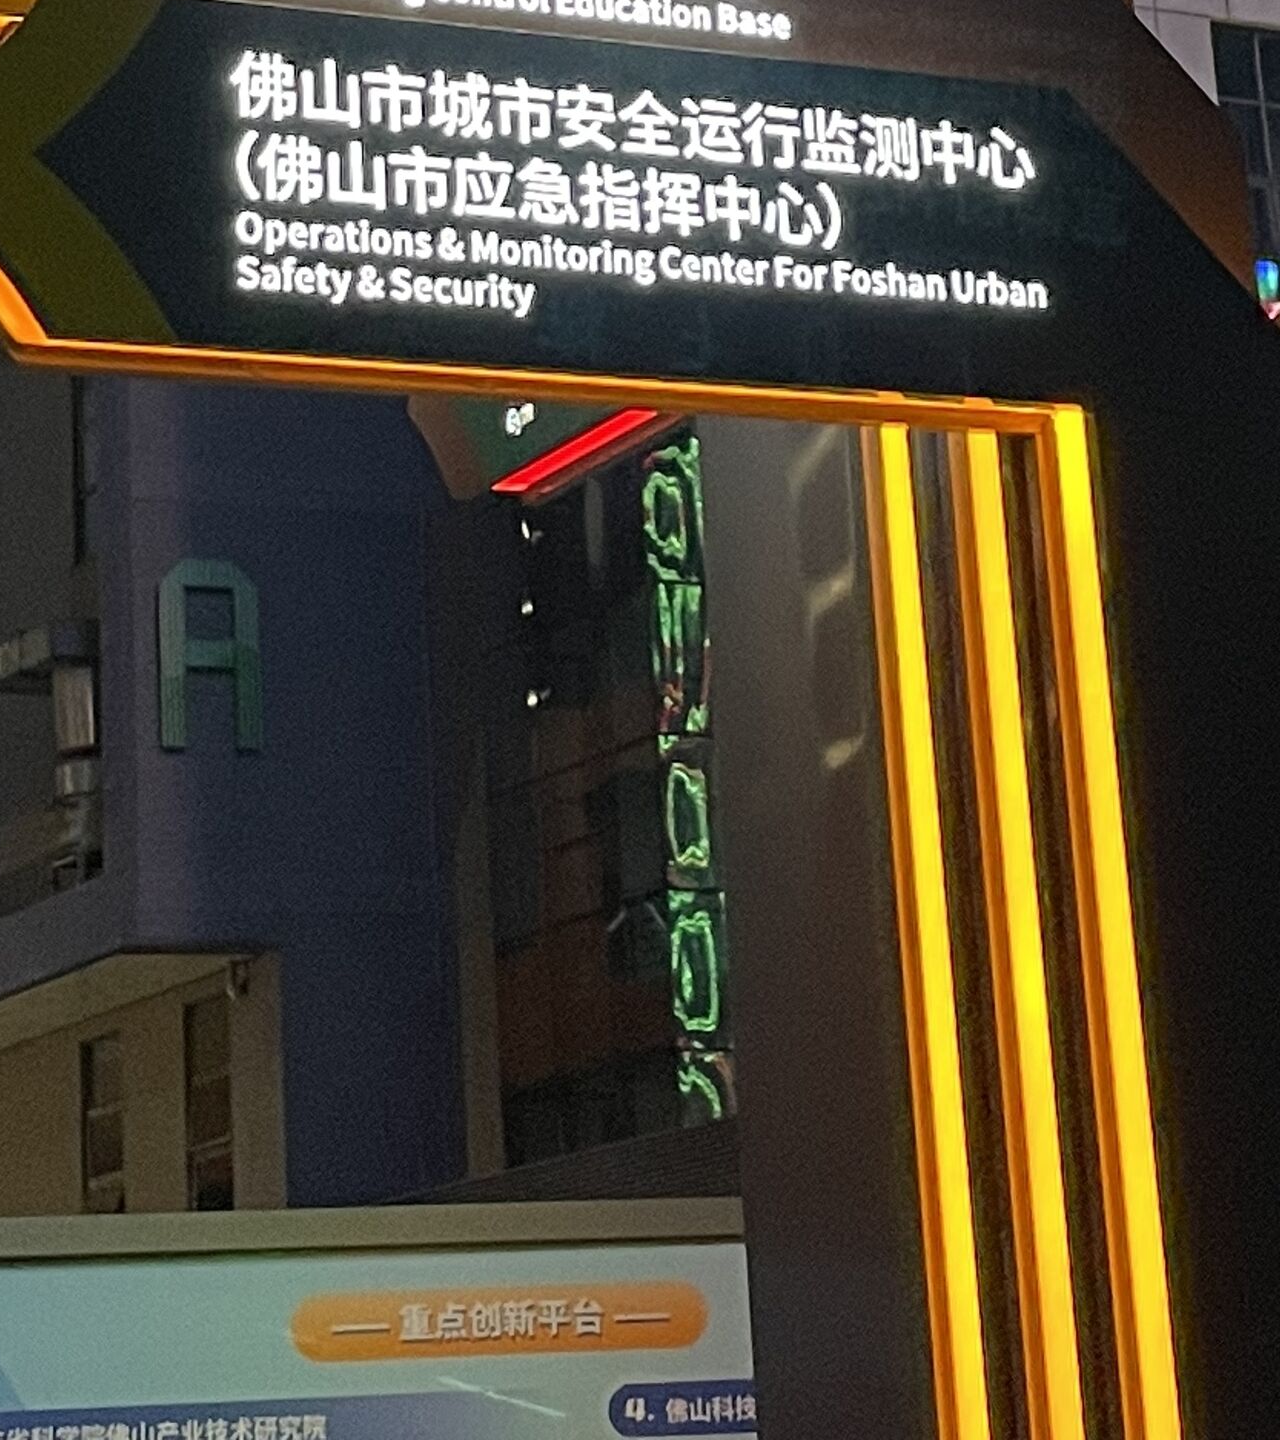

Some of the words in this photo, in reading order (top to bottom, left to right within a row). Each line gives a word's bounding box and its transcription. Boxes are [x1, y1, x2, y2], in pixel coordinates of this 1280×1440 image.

[717, 1, 792, 42] Base
[230, 49, 1037, 190] 佛山市城市安全运行监测中心
[236, 128, 843, 251] (佛山市应急指挥中心)
[235, 210, 432, 261] Operations
[470, 229, 658, 287] Monitoring
[659, 244, 770, 287] Center
[773, 255, 828, 292] For
[832, 260, 948, 304] Foshan
[950, 270, 1049, 310] Urban
[235, 254, 353, 305] Safety
[388, 265, 536, 318] Security
[157, 559, 264, 750] A
[398, 1297, 605, 1343] 重点创新平台
